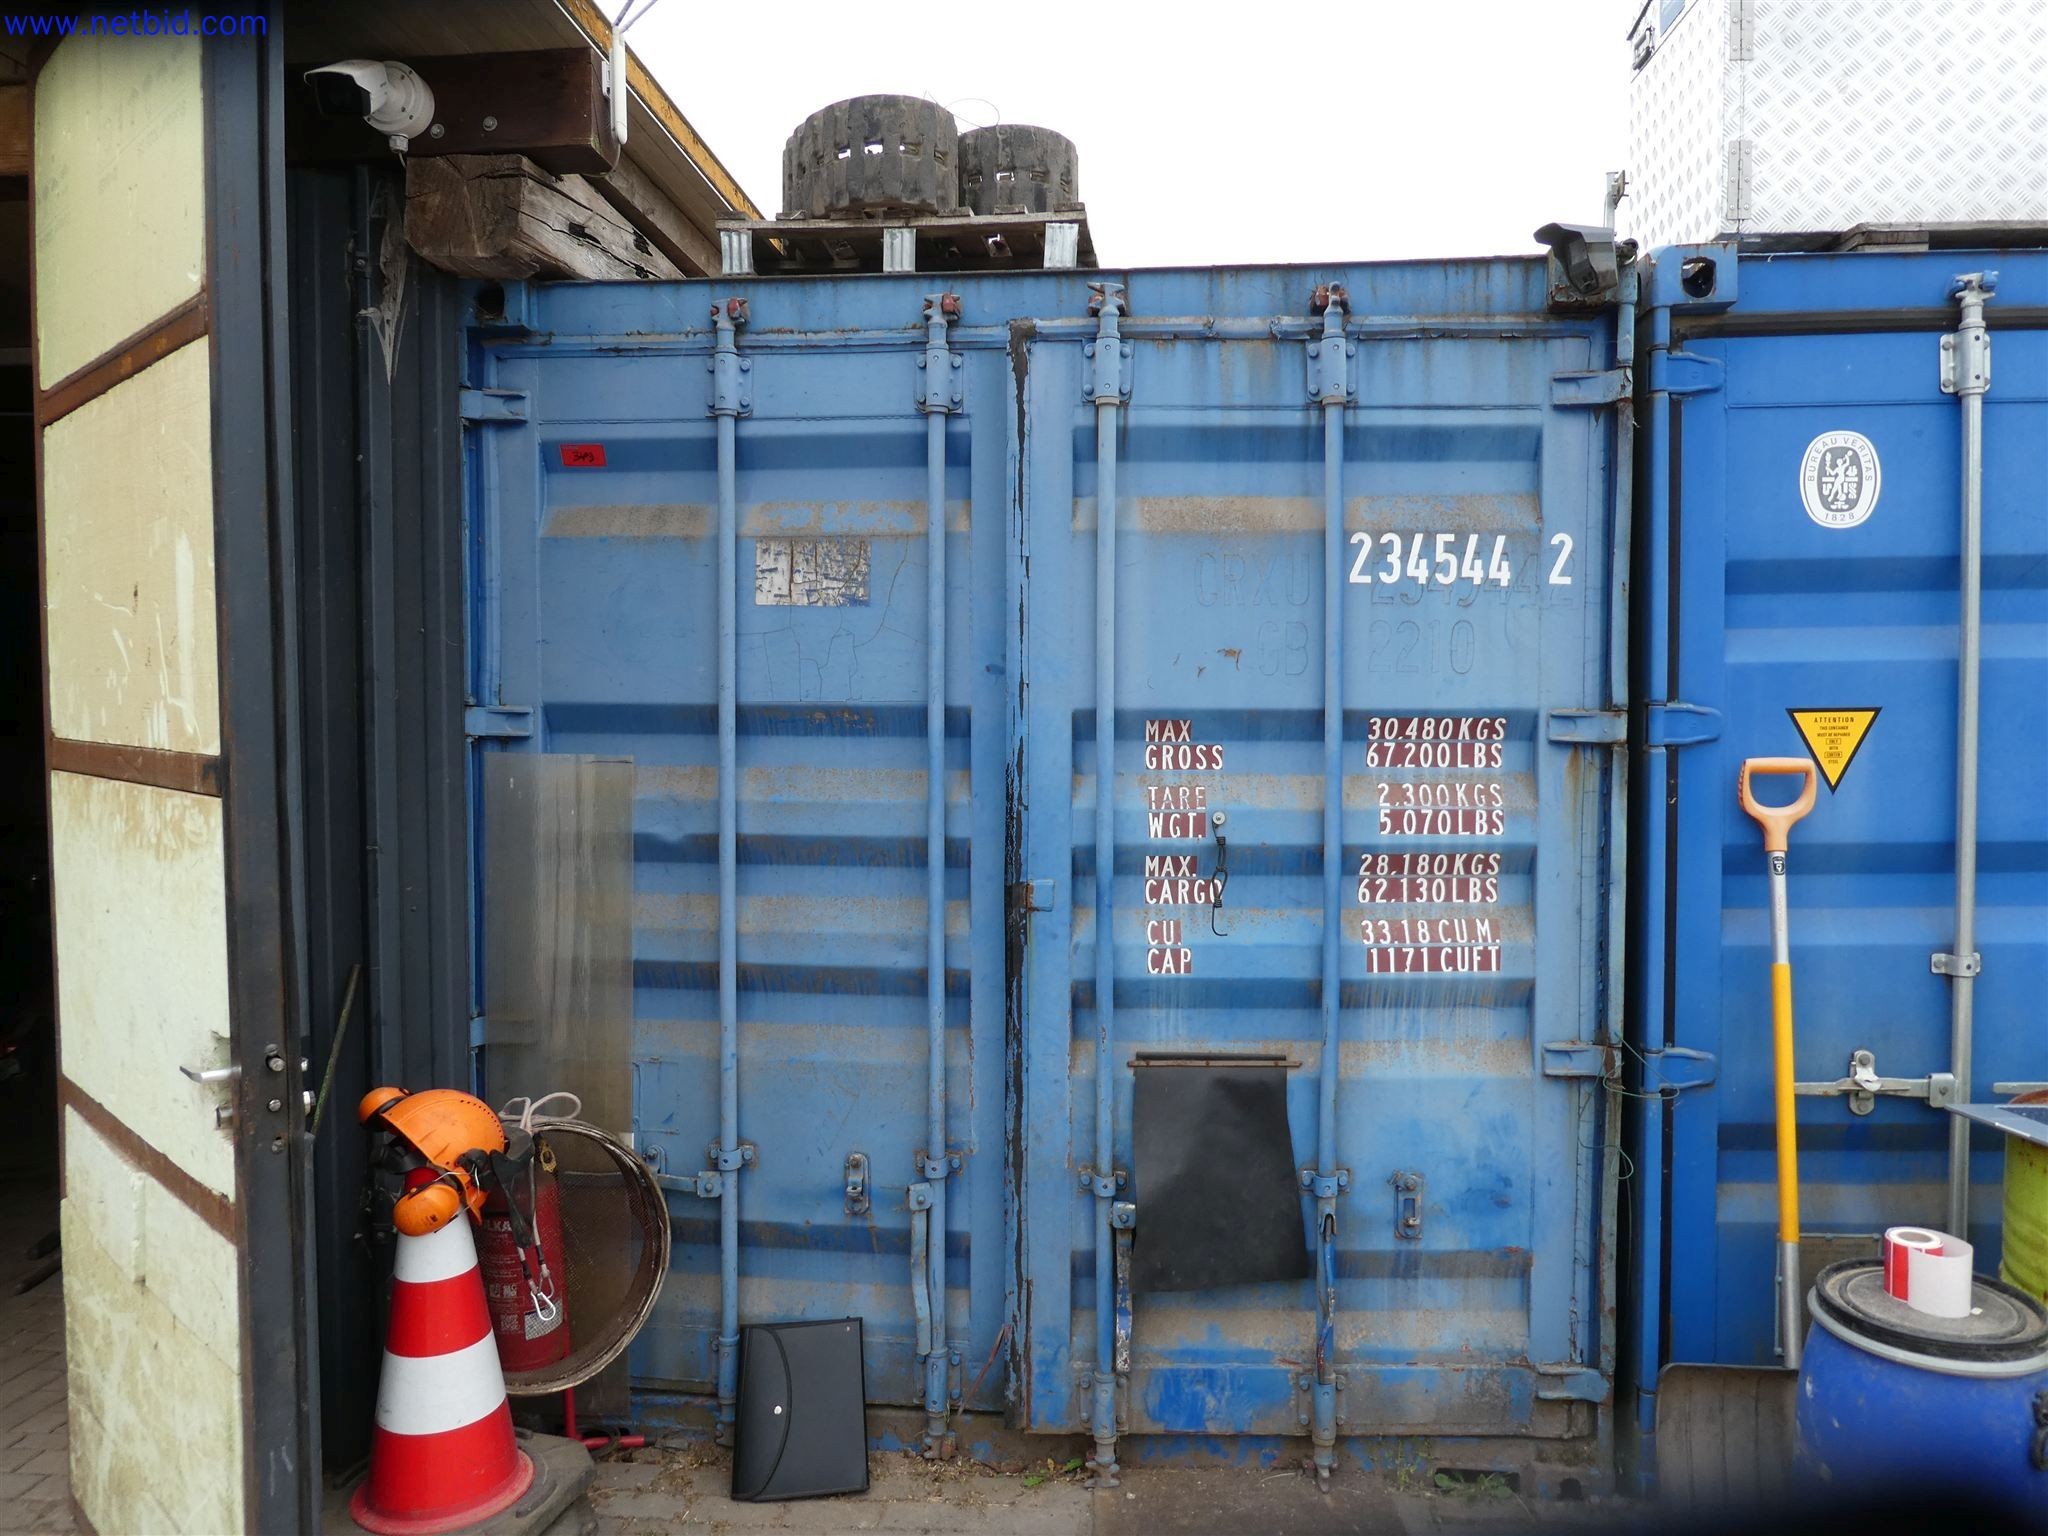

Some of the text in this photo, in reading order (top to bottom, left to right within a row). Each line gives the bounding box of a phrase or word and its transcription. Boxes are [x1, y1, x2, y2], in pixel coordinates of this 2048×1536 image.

[1807, 437, 1873, 482] BUREAU VERITAS
[1824, 512, 1855, 521] 1828
[1349, 532, 1574, 587] 234544 2
[1145, 719, 1192, 742] MAX
[1145, 744, 1223, 770] GROSS
[1148, 786, 1206, 810] TARE
[1148, 812, 1202, 838] WGT.
[1145, 855, 1197, 877] MAX.
[1145, 879, 1223, 904] CARGO
[1147, 920, 1182, 945] CU.
[1147, 948, 1192, 974] CAP
